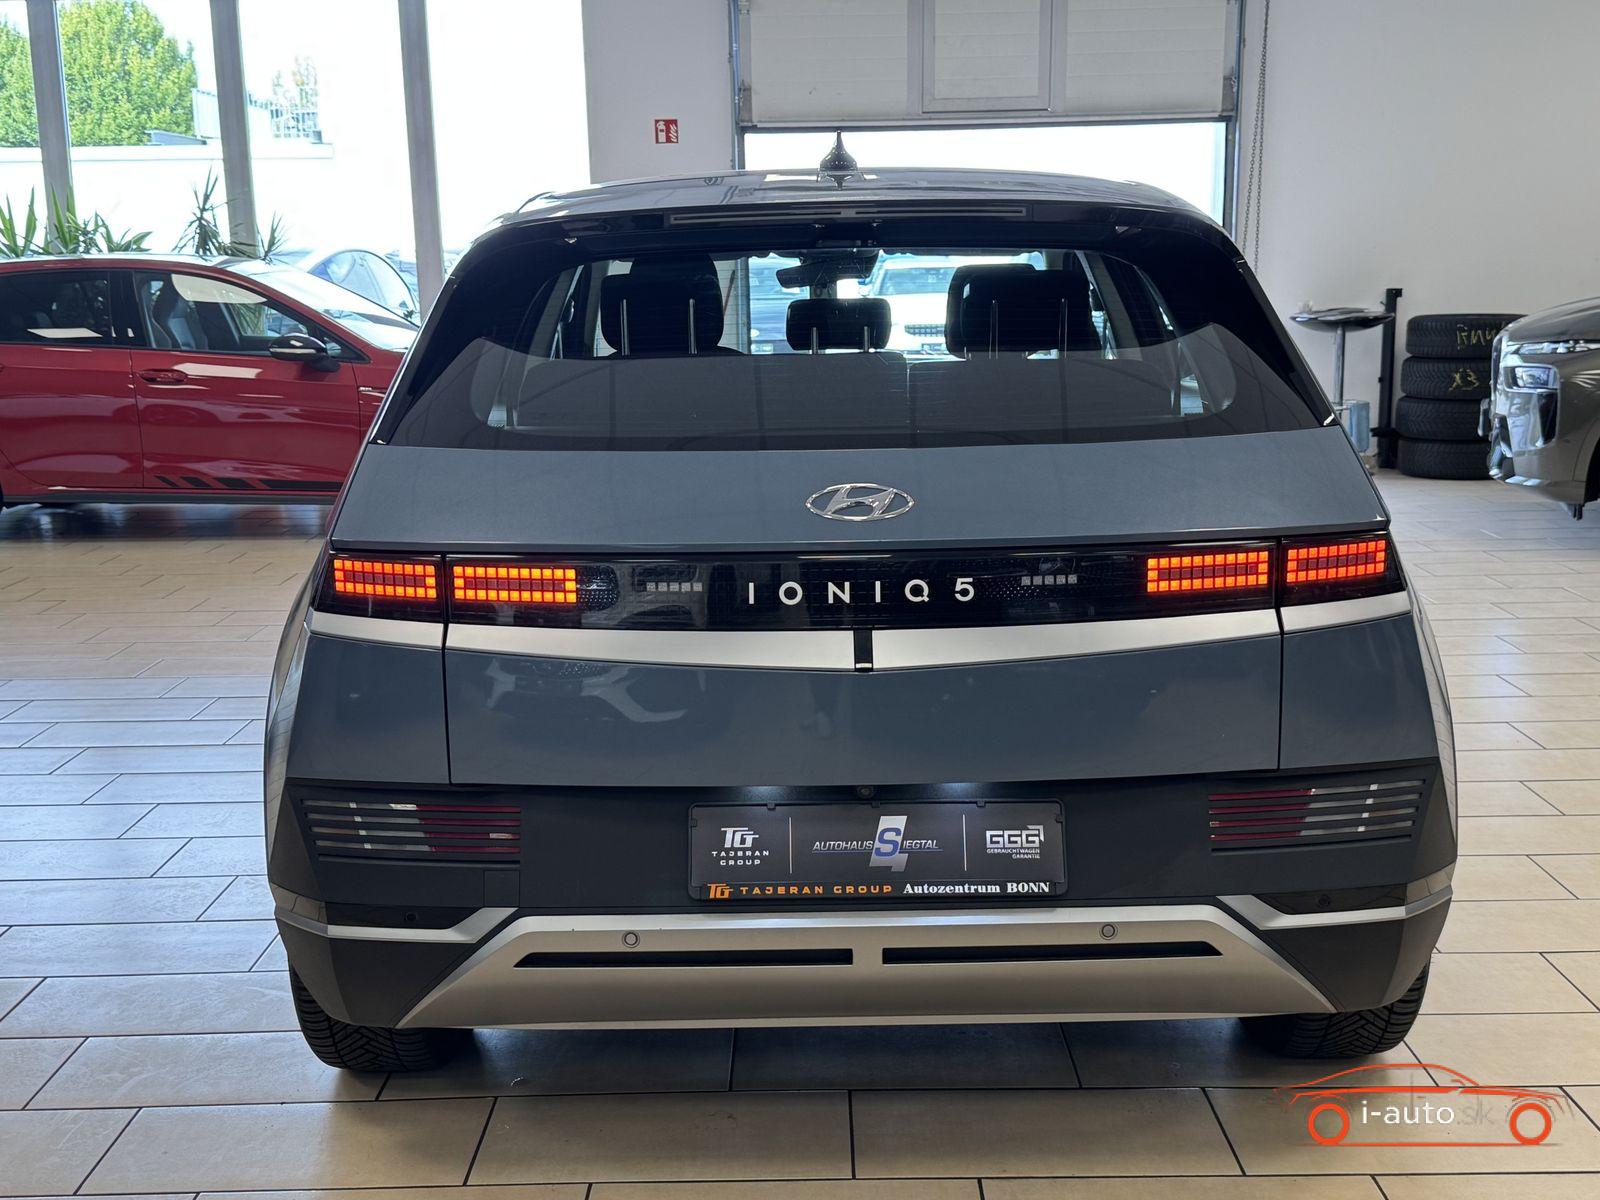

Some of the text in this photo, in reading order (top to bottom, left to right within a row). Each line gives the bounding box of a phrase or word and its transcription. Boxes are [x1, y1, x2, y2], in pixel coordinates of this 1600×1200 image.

[748, 577, 975, 605] IONIQ 5
[812, 840, 874, 851] AUTOHAUS
[986, 830, 1040, 848] GGG
[740, 886, 824, 895] TAJERAN
[833, 885, 892, 894] GROUP
[903, 883, 1001, 894] Autozentrum
[1006, 882, 1050, 893] BONN
